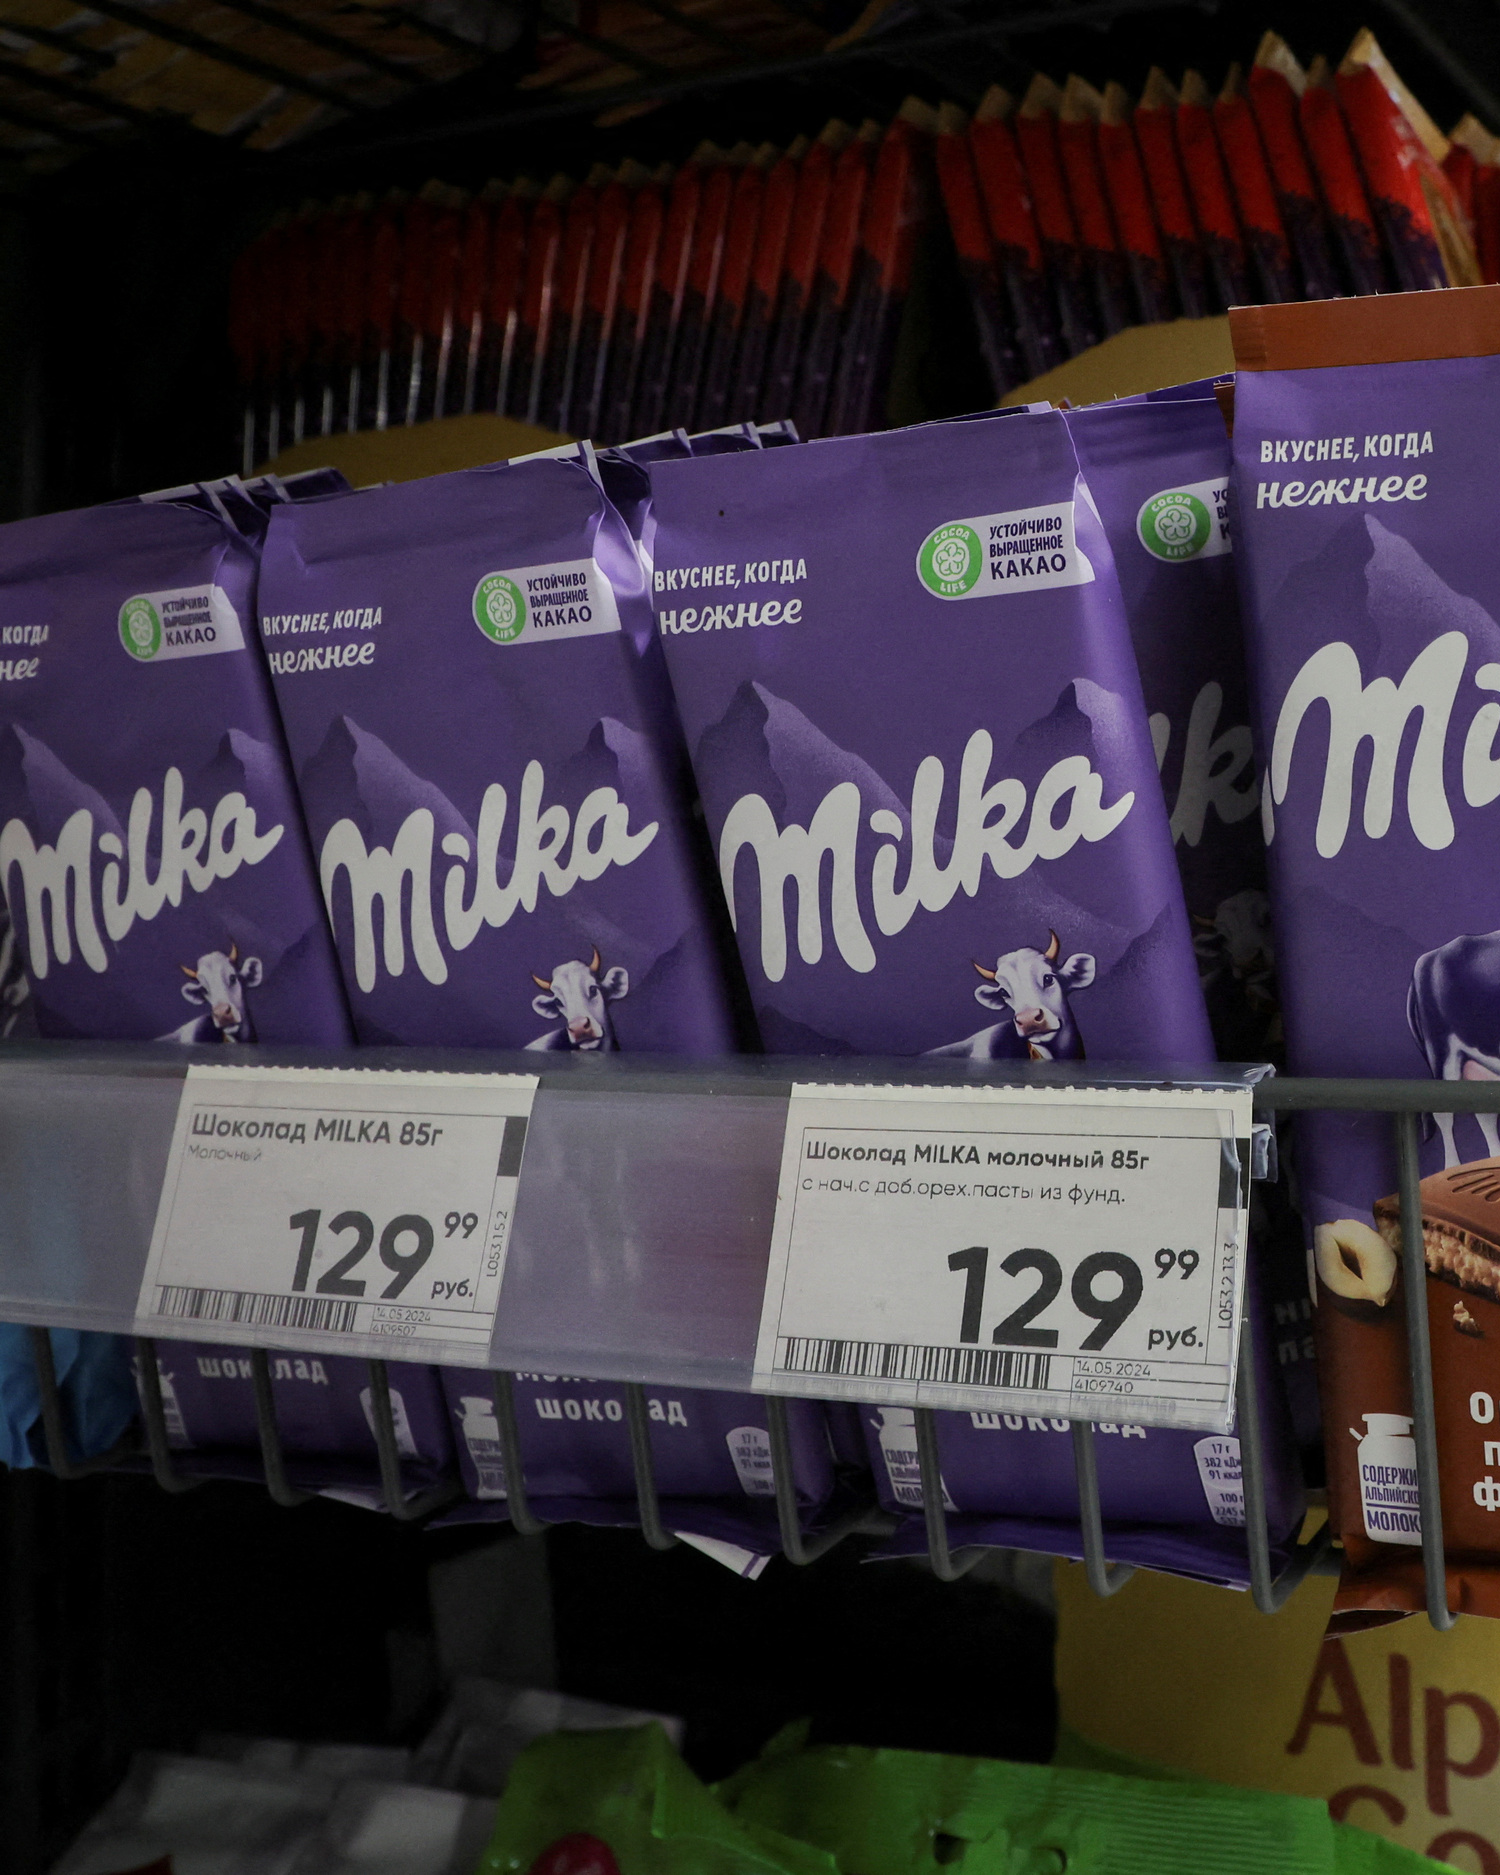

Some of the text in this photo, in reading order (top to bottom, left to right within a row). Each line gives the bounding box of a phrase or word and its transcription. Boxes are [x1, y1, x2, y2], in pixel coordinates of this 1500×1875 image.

[1260, 430, 1434, 464] ВКУСНЕЕ, КОГДА
[1151, 495, 1192, 512] COCOA
[1256, 473, 1428, 510] нежнее
[933, 528, 971, 544] COCOA
[989, 516, 1063, 540] УСТОЙЧИВО
[989, 534, 1064, 558] ВЫРАЩЕННОЕ
[654, 558, 808, 593] ВКУСНЕЕ, КОГДА
[990, 553, 1067, 580] КАКАО
[527, 572, 587, 593] УСТОЙЧИВО
[940, 579, 967, 594] LIFE
[530, 589, 589, 609] ВЫРАЩЕННОЕ
[263, 607, 383, 637] ВКУСНЕЕ, КОГДА
[532, 605, 592, 629] КАКАО
[659, 598, 803, 635] нежнее
[2, 625, 49, 646] КОГДА
[165, 627, 216, 646] КАКАО
[0, 657, 40, 681] нее
[268, 642, 376, 675] нежнее
[720, 729, 1135, 983] Milka
[0, 766, 284, 980] Milka
[320, 760, 659, 993] Milka
[192, 1113, 443, 1147] Шоколад MILKA 85г
[806, 1141, 1150, 1170] Шоколад MILKA молочный 85г
[802, 1178, 813, 1191] с
[1040, 1187, 1062, 1200] из
[1068, 1183, 1126, 1205] фунд.
[444, 1211, 479, 1239] 99
[289, 1208, 435, 1299] 129
[1154, 1248, 1201, 1280] 99
[431, 1278, 474, 1300] руб.
[947, 1246, 1144, 1352] 129
[1147, 1324, 1205, 1351] руб.
[197, 1357, 328, 1385] шоклад
[1077, 1360, 1151, 1377] 14.05.2024
[1074, 1379, 1134, 1394] 4109740
[535, 1398, 688, 1427] шокоад
[970, 1411, 1147, 1439] шоко
[1204, 1457, 1221, 1468] 382
[1212, 1444, 1222, 1454] 17
[1209, 1470, 1221, 1479] 91
[1363, 1465, 1418, 1487] СОДЕРЖИ
[1365, 1486, 1420, 1504] АЛЬПИЙСКО
